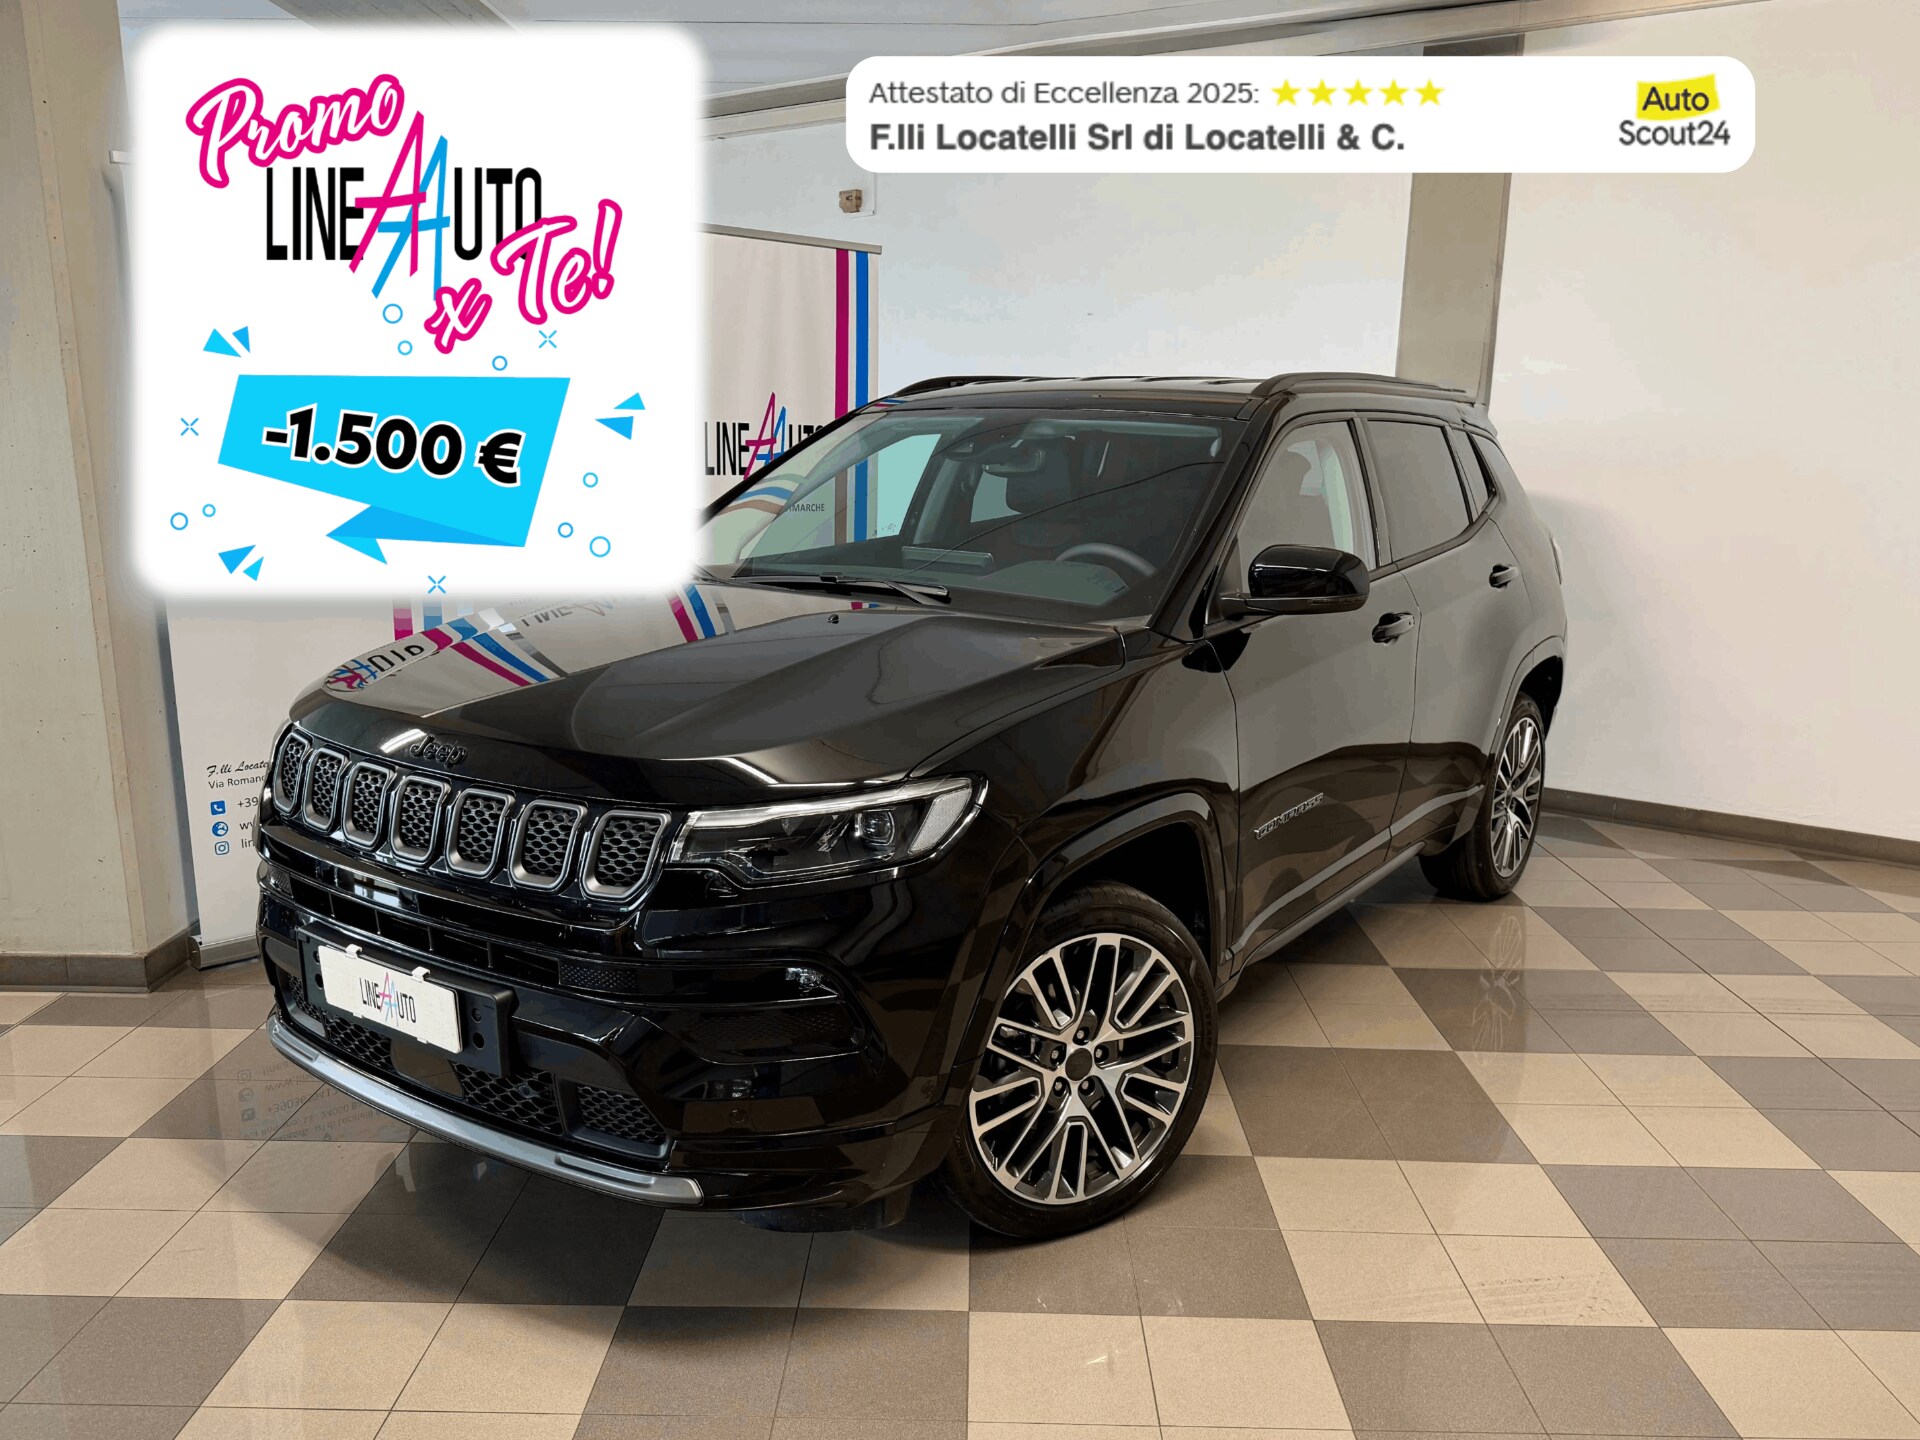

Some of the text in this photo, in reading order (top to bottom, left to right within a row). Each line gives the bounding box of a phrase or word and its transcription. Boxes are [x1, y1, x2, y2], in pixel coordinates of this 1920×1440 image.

[410, 734, 467, 768] Jeep
[208, 780, 224, 789] Via
[237, 797, 259, 808] +39
[1254, 792, 1324, 840] COMPASS
